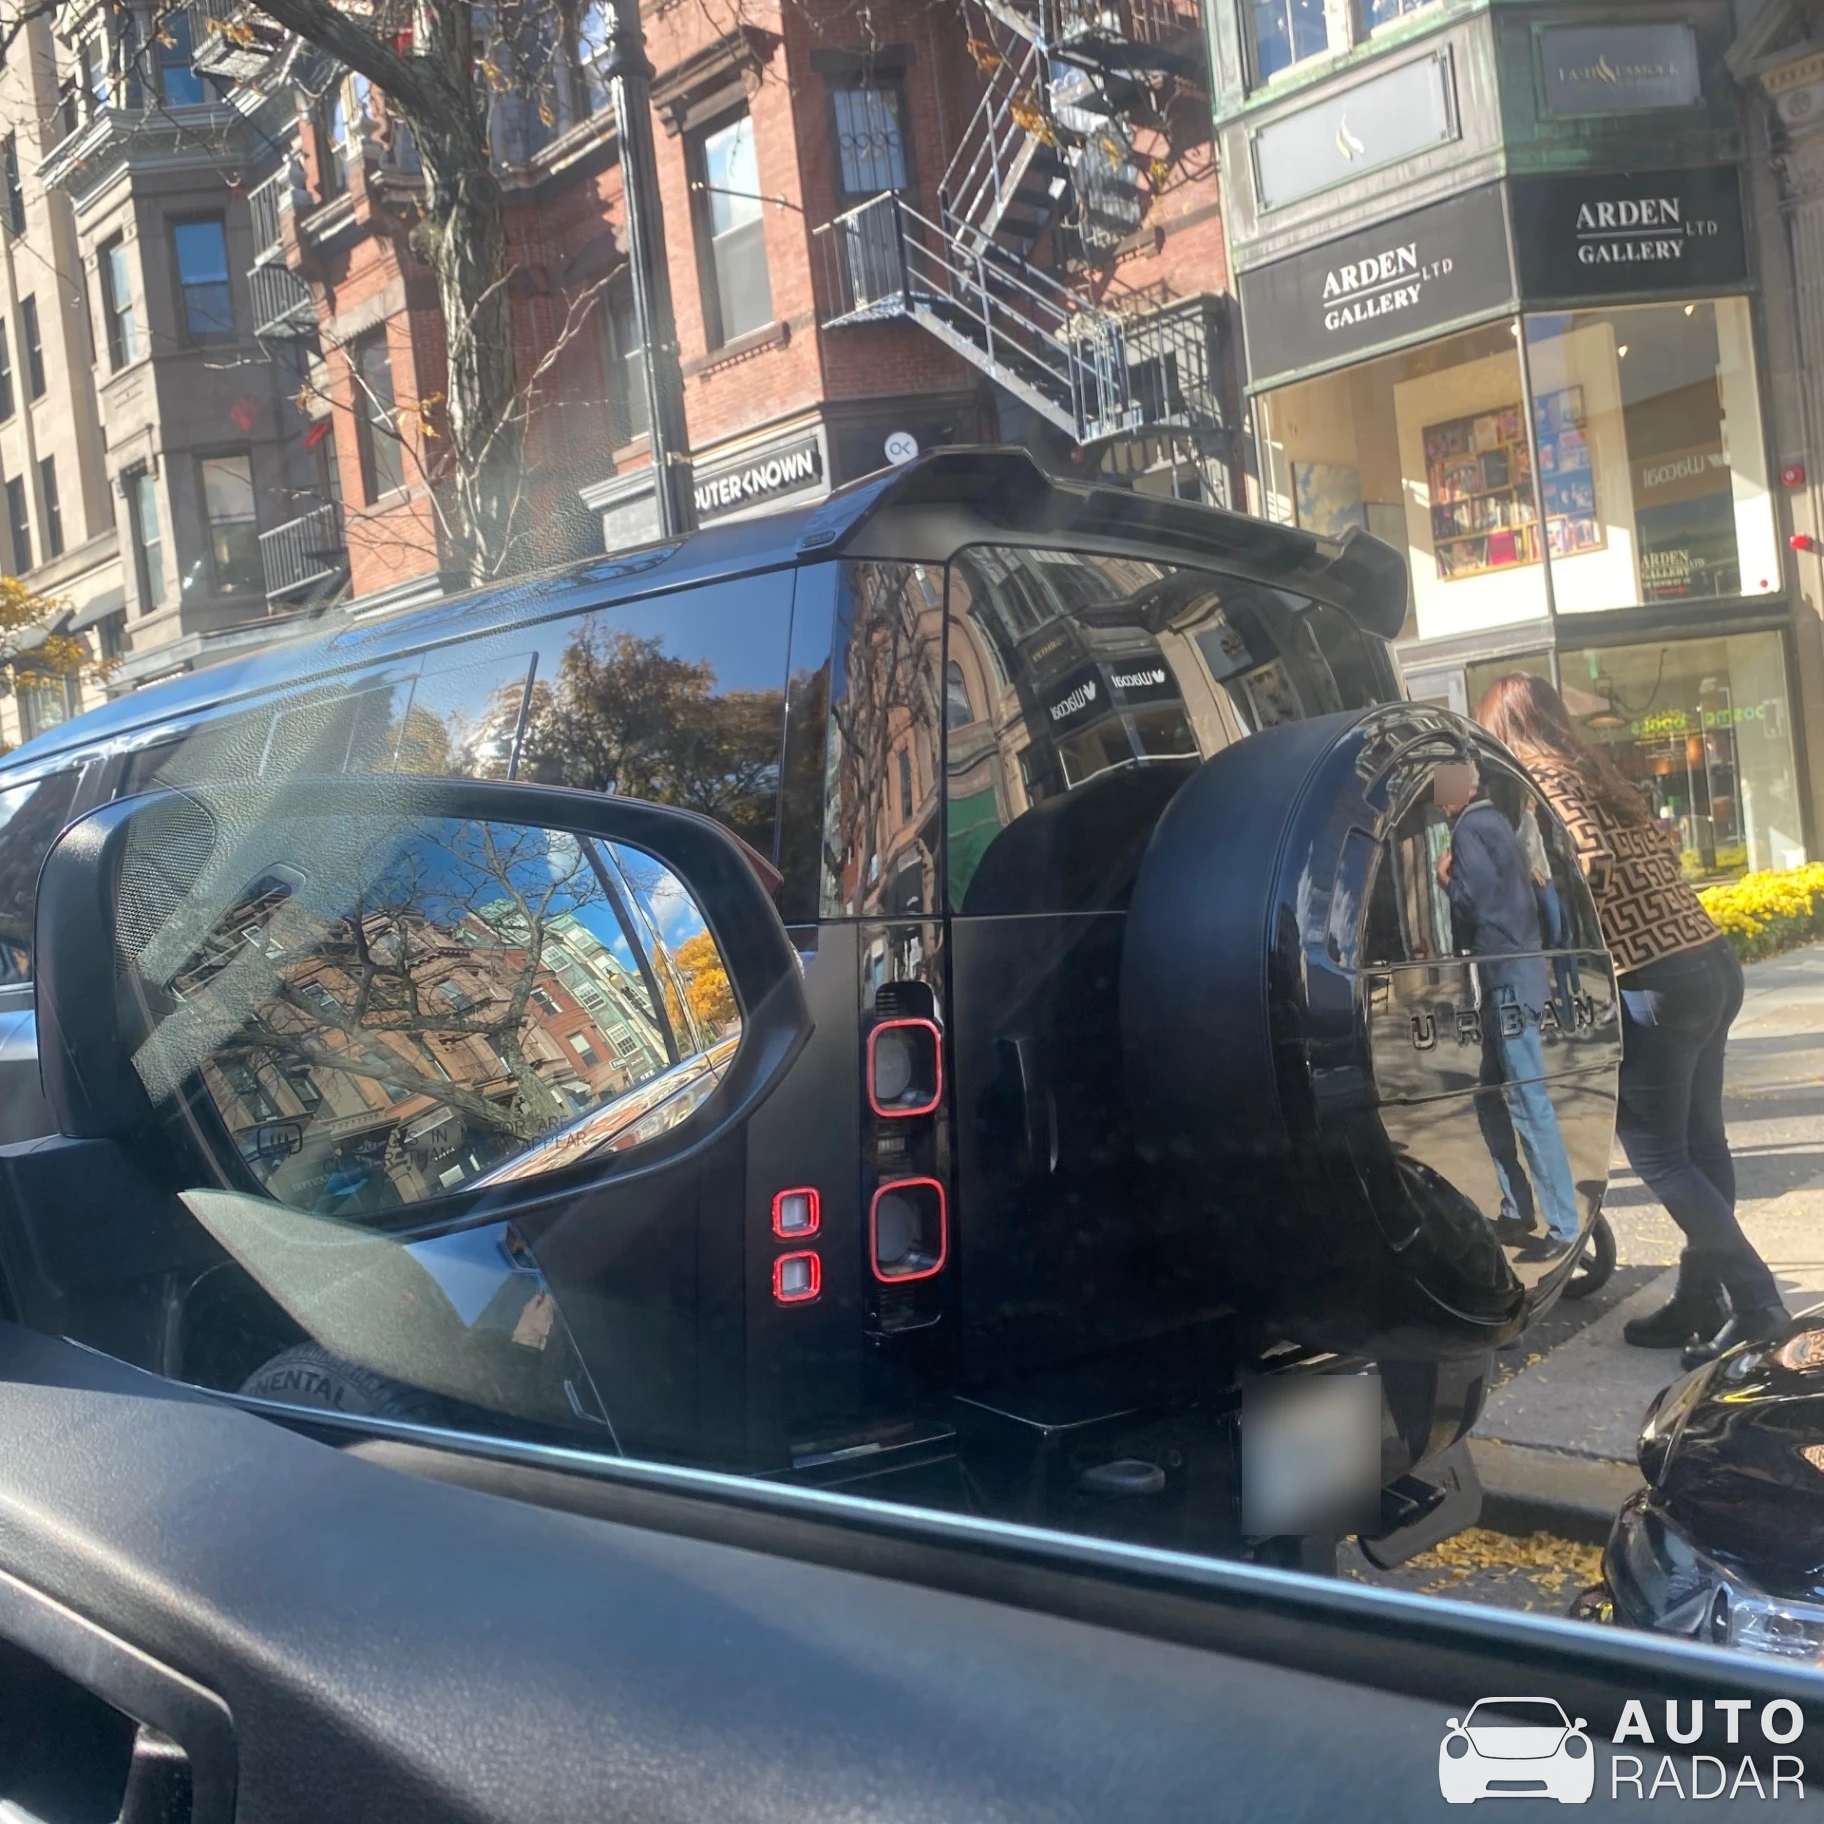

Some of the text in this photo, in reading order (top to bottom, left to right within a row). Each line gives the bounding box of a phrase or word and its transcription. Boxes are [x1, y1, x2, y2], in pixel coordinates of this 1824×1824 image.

[1575, 197, 1680, 230] ARDEN
[1685, 220, 1718, 237] LTD
[1577, 239, 1684, 265] GALLERY
[1322, 242, 1418, 299] ARDEN
[1421, 257, 1454, 281] LTD
[1324, 283, 1421, 331] GALLERY
[1641, 549, 1689, 569] ARDEN
[1409, 995, 1595, 1050] URBAN
[430, 1127, 448, 1144] IN
[538, 1114, 569, 1133] ARE
